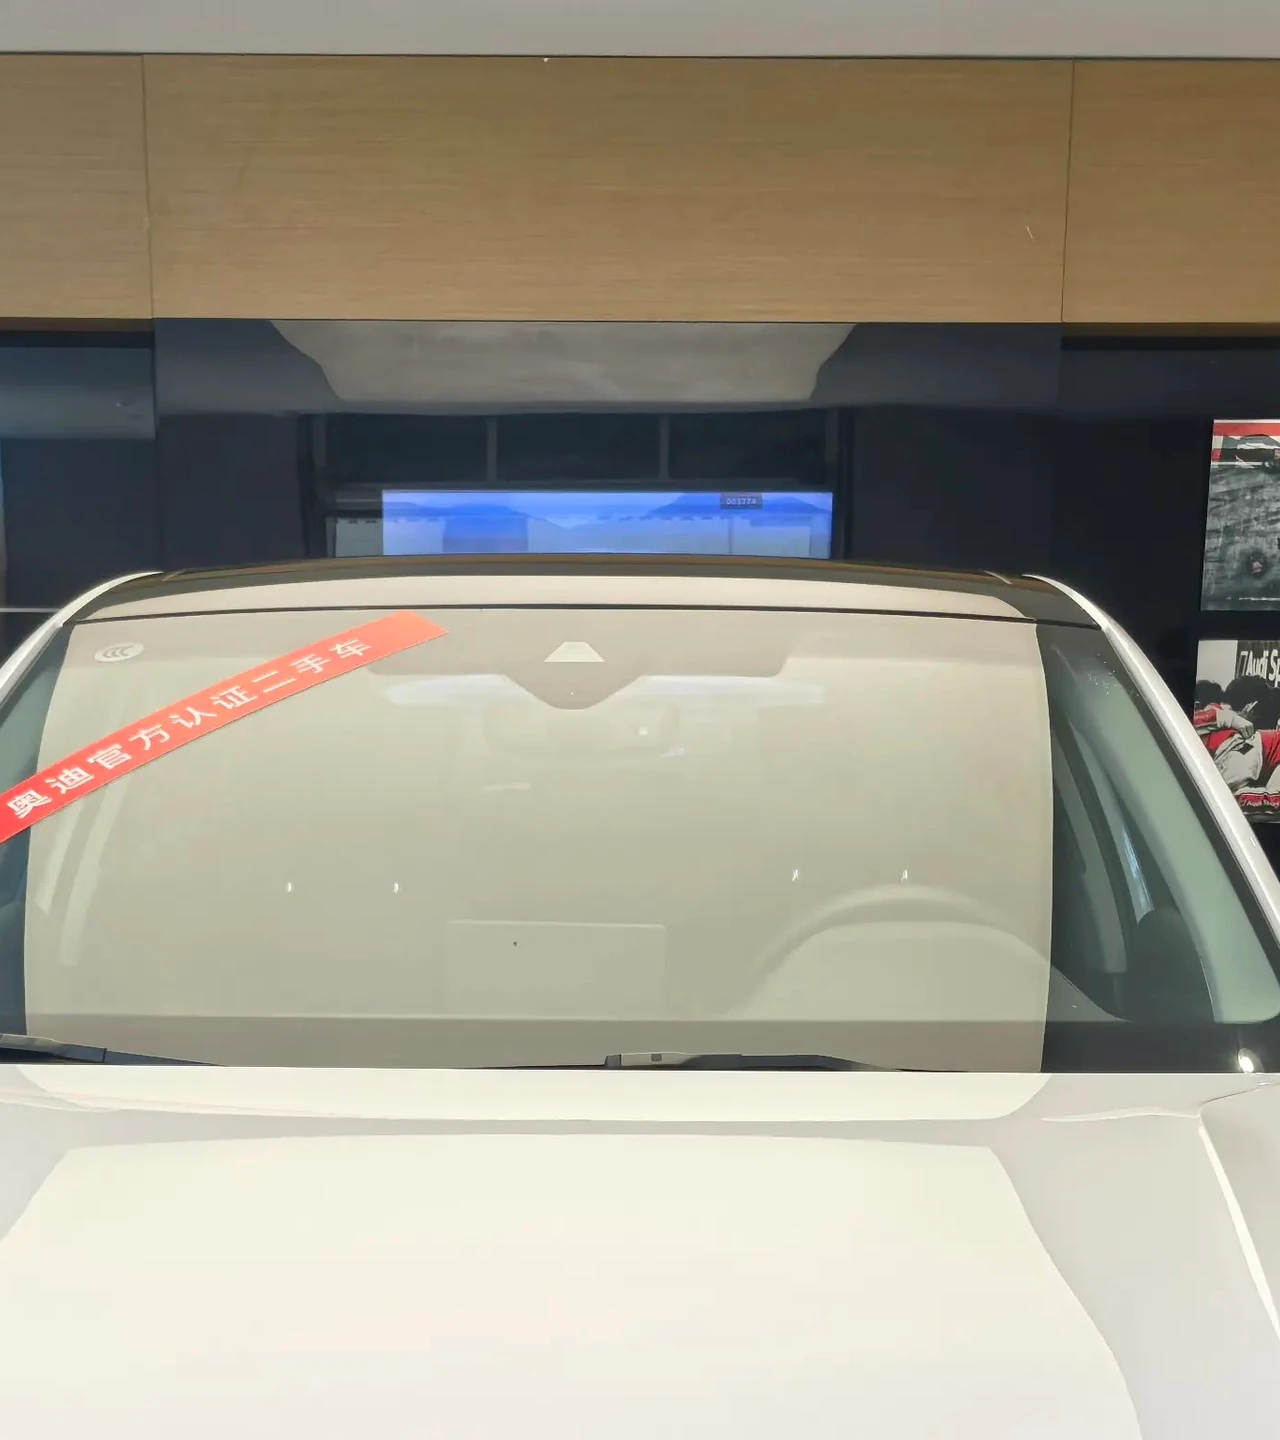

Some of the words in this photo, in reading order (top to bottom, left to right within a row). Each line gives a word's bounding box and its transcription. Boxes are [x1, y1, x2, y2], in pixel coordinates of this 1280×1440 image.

[1245, 650, 1269, 679] Audi
[7, 638, 372, 818] 奥迪官方认证二手车
